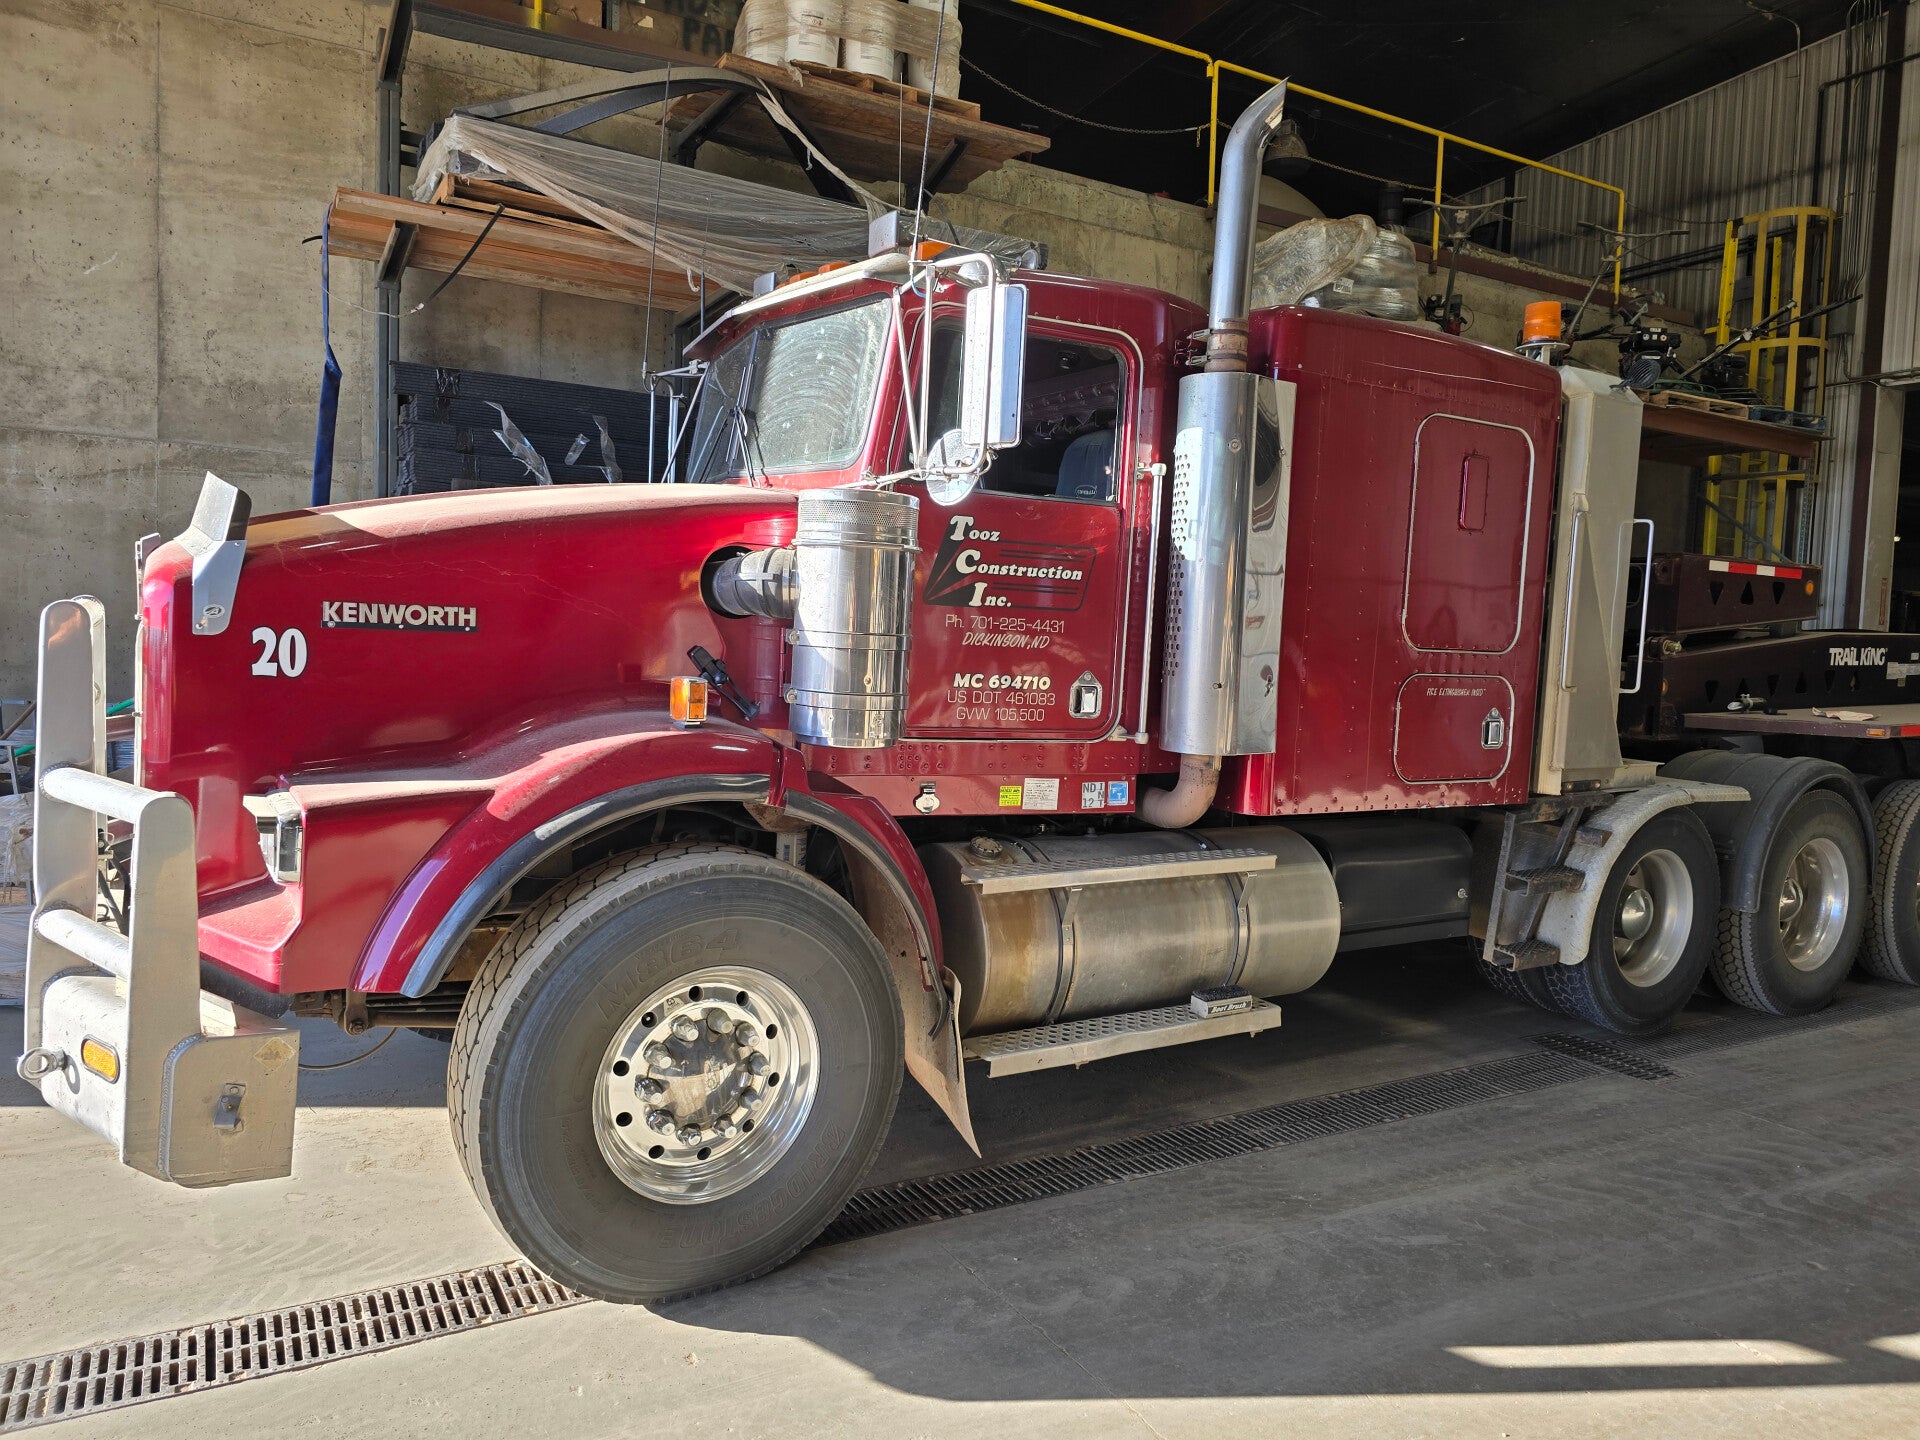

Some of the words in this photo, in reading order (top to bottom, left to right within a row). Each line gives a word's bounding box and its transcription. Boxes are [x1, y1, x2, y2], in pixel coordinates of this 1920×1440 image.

[950, 515, 1000, 541] Tooz
[955, 549, 1082, 581] Construction
[968, 582, 1012, 607] Inc.
[322, 601, 477, 627] KENWORTH
[945, 614, 965, 628] Ph.
[970, 615, 1065, 633] 701-225-4431
[251, 626, 308, 678] 20
[953, 673, 984, 689] MC
[988, 674, 1051, 690] 694710
[947, 690, 967, 704] US
[972, 691, 1001, 705] DOT
[1005, 692, 1056, 706] 461083
[956, 707, 990, 721] GVW
[994, 707, 1045, 722] 105,500
[1083, 783, 1096, 793] ND
